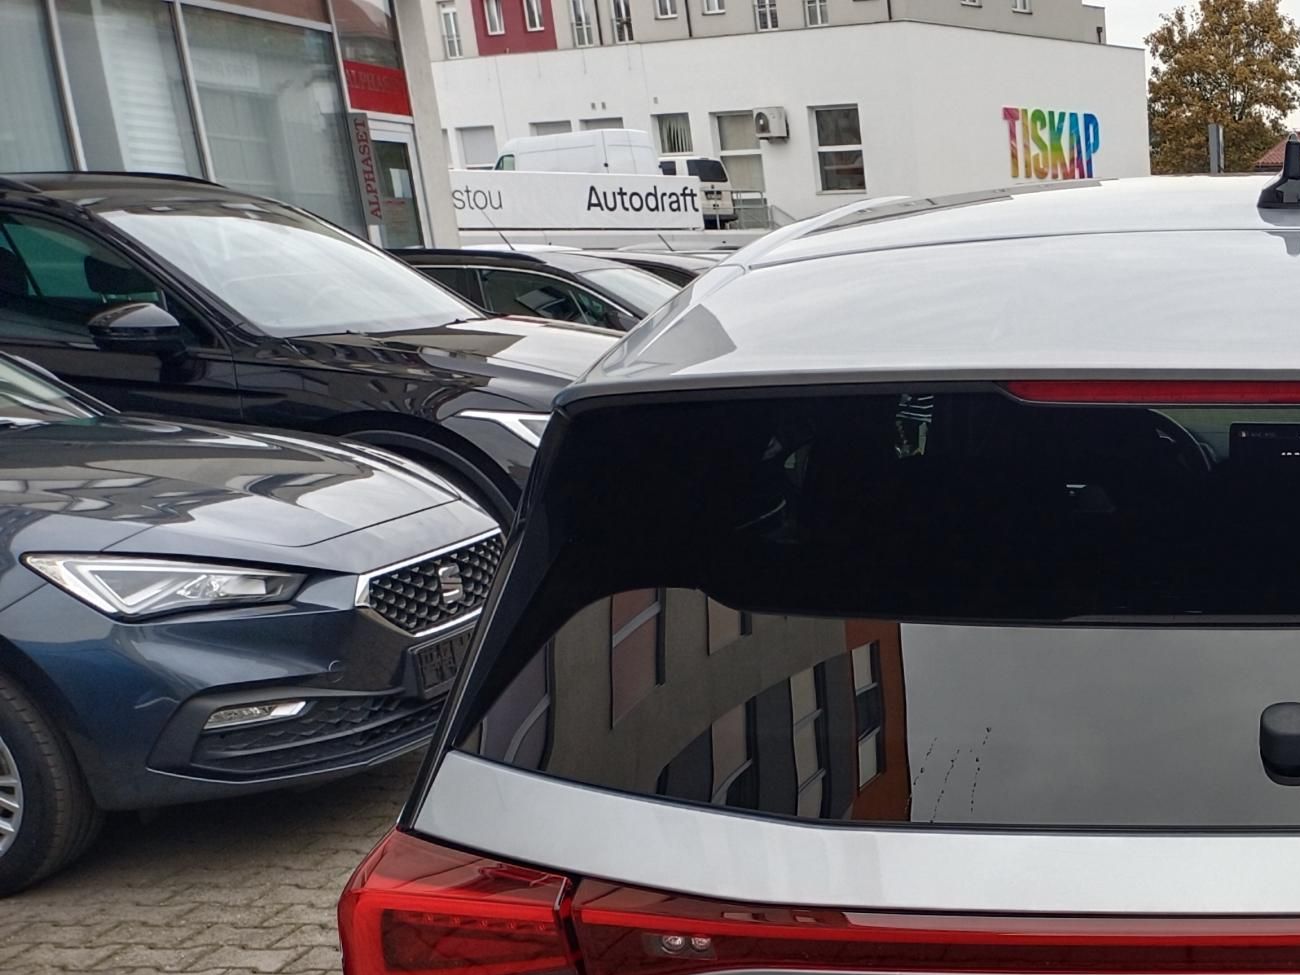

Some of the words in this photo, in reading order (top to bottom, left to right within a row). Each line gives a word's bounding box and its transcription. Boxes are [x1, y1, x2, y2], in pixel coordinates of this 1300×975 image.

[1003, 107, 1100, 180] TISKAP
[354, 118, 383, 220] ALPHASET
[451, 185, 503, 210] stou
[586, 185, 699, 212] Autodraft
